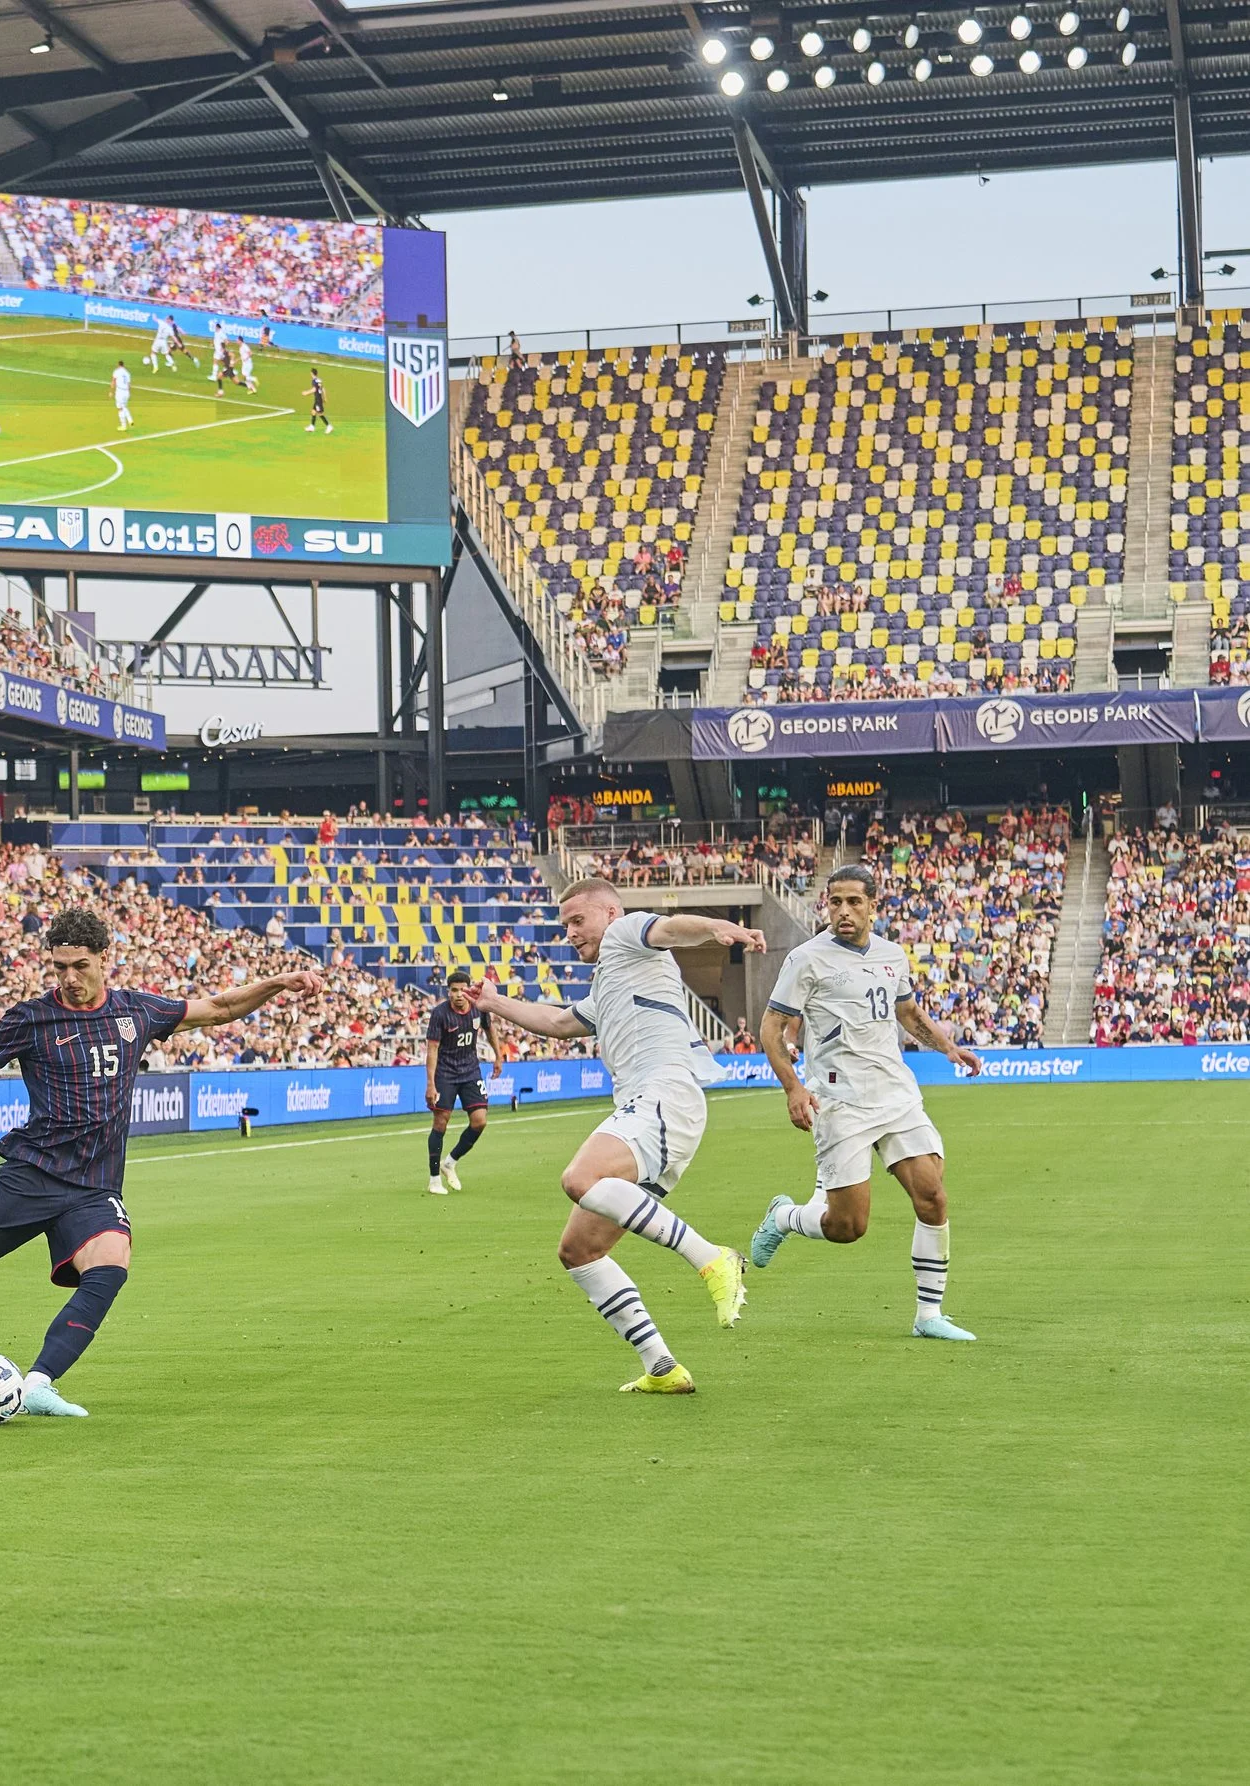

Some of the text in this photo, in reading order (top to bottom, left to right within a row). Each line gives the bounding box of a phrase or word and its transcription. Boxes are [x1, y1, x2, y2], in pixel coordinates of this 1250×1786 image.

[393, 342, 439, 375] USA
[99, 517, 115, 546] 0
[126, 522, 216, 553] 10:15
[226, 522, 242, 551] 0
[303, 529, 384, 555] SUI
[7, 681, 42, 713] GEODIS
[68, 698, 100, 728] GEODIS
[124, 713, 154, 741] GEODIS
[780, 715, 898, 735] GEODIS PARK
[1029, 704, 1152, 726] GEODIS PARK
[200, 713, 265, 748] Cesar
[603, 789, 654, 806] BANDA
[865, 986, 889, 1020] 13
[456, 1031, 473, 1047] 20
[89, 1044, 120, 1078] 15
[1201, 1051, 1250, 1073] ticke
[197, 1084, 249, 1118] ticketmaster
[286, 1081, 332, 1113] ticketmaster
[476, 1079, 488, 1096] 2
[142, 1086, 184, 1122] Match
[107, 1196, 131, 1222] 1
